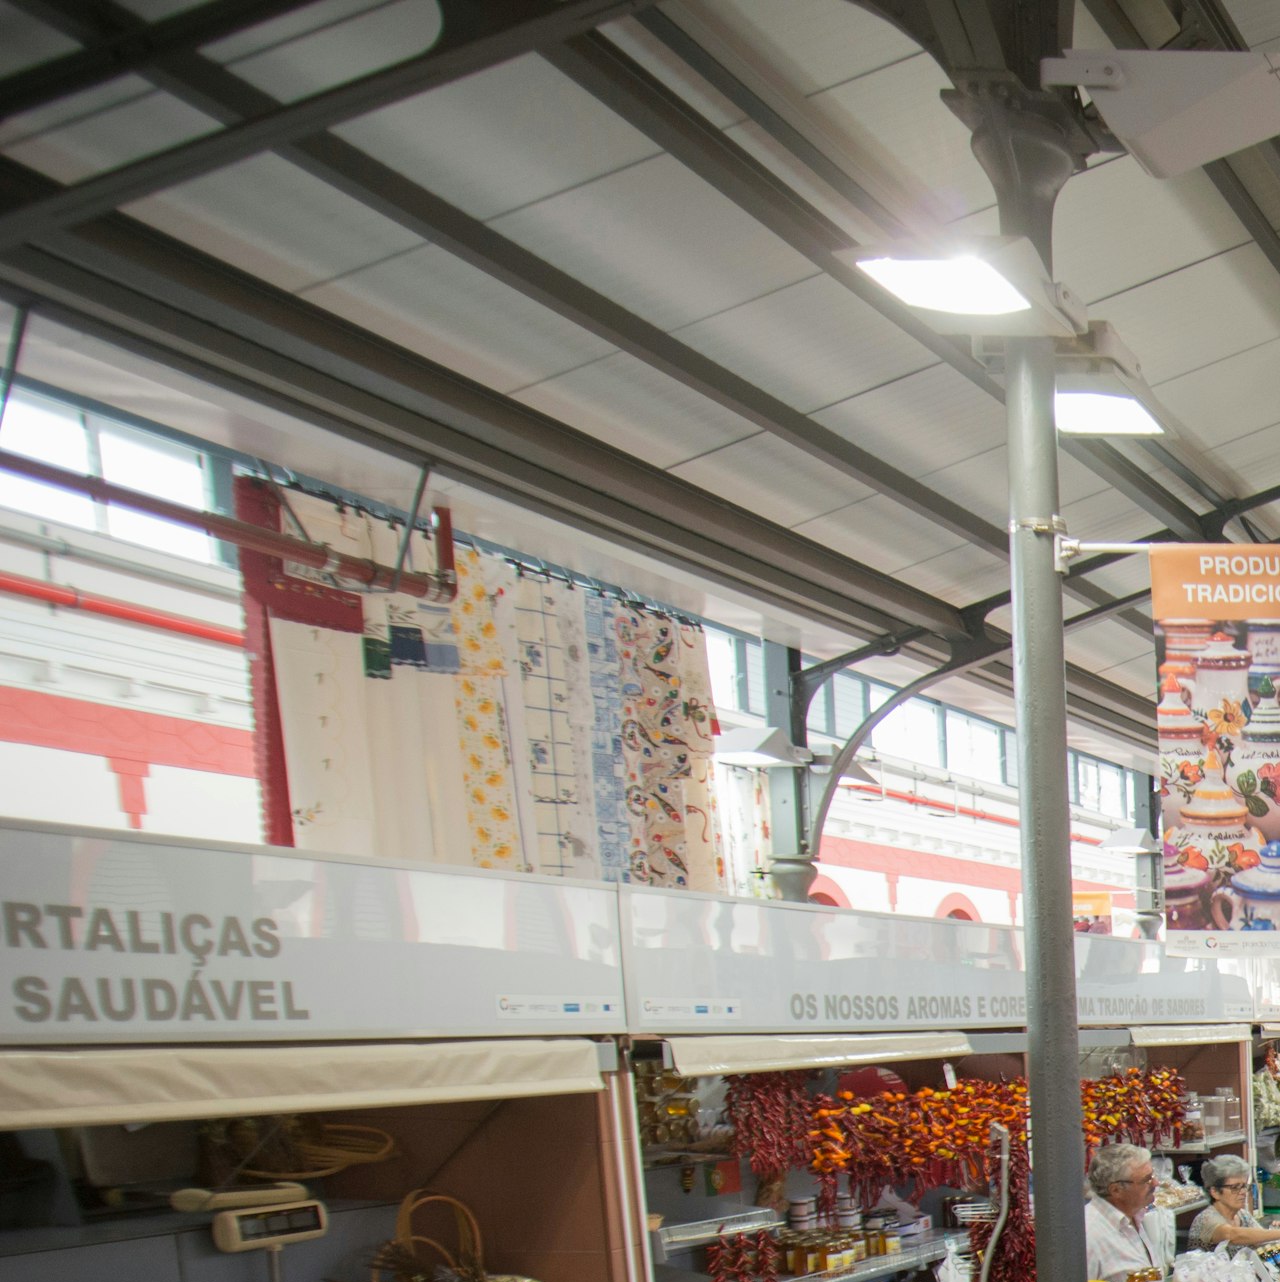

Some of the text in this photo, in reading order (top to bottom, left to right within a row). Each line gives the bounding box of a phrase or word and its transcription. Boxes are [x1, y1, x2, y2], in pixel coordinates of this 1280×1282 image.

[3, 901, 281, 967] RTALIÇAS
[12, 969, 310, 1023] SAUDÁVEL
[790, 993, 818, 1021] OS
[824, 994, 900, 1021] NOSSOS
[906, 996, 971, 1020] AROMAS
[977, 996, 987, 1018] E
[1098, 994, 1148, 1019] TRADIÇÃO
[1152, 998, 1164, 1016] DE
[1167, 998, 1206, 1016] SABORES
